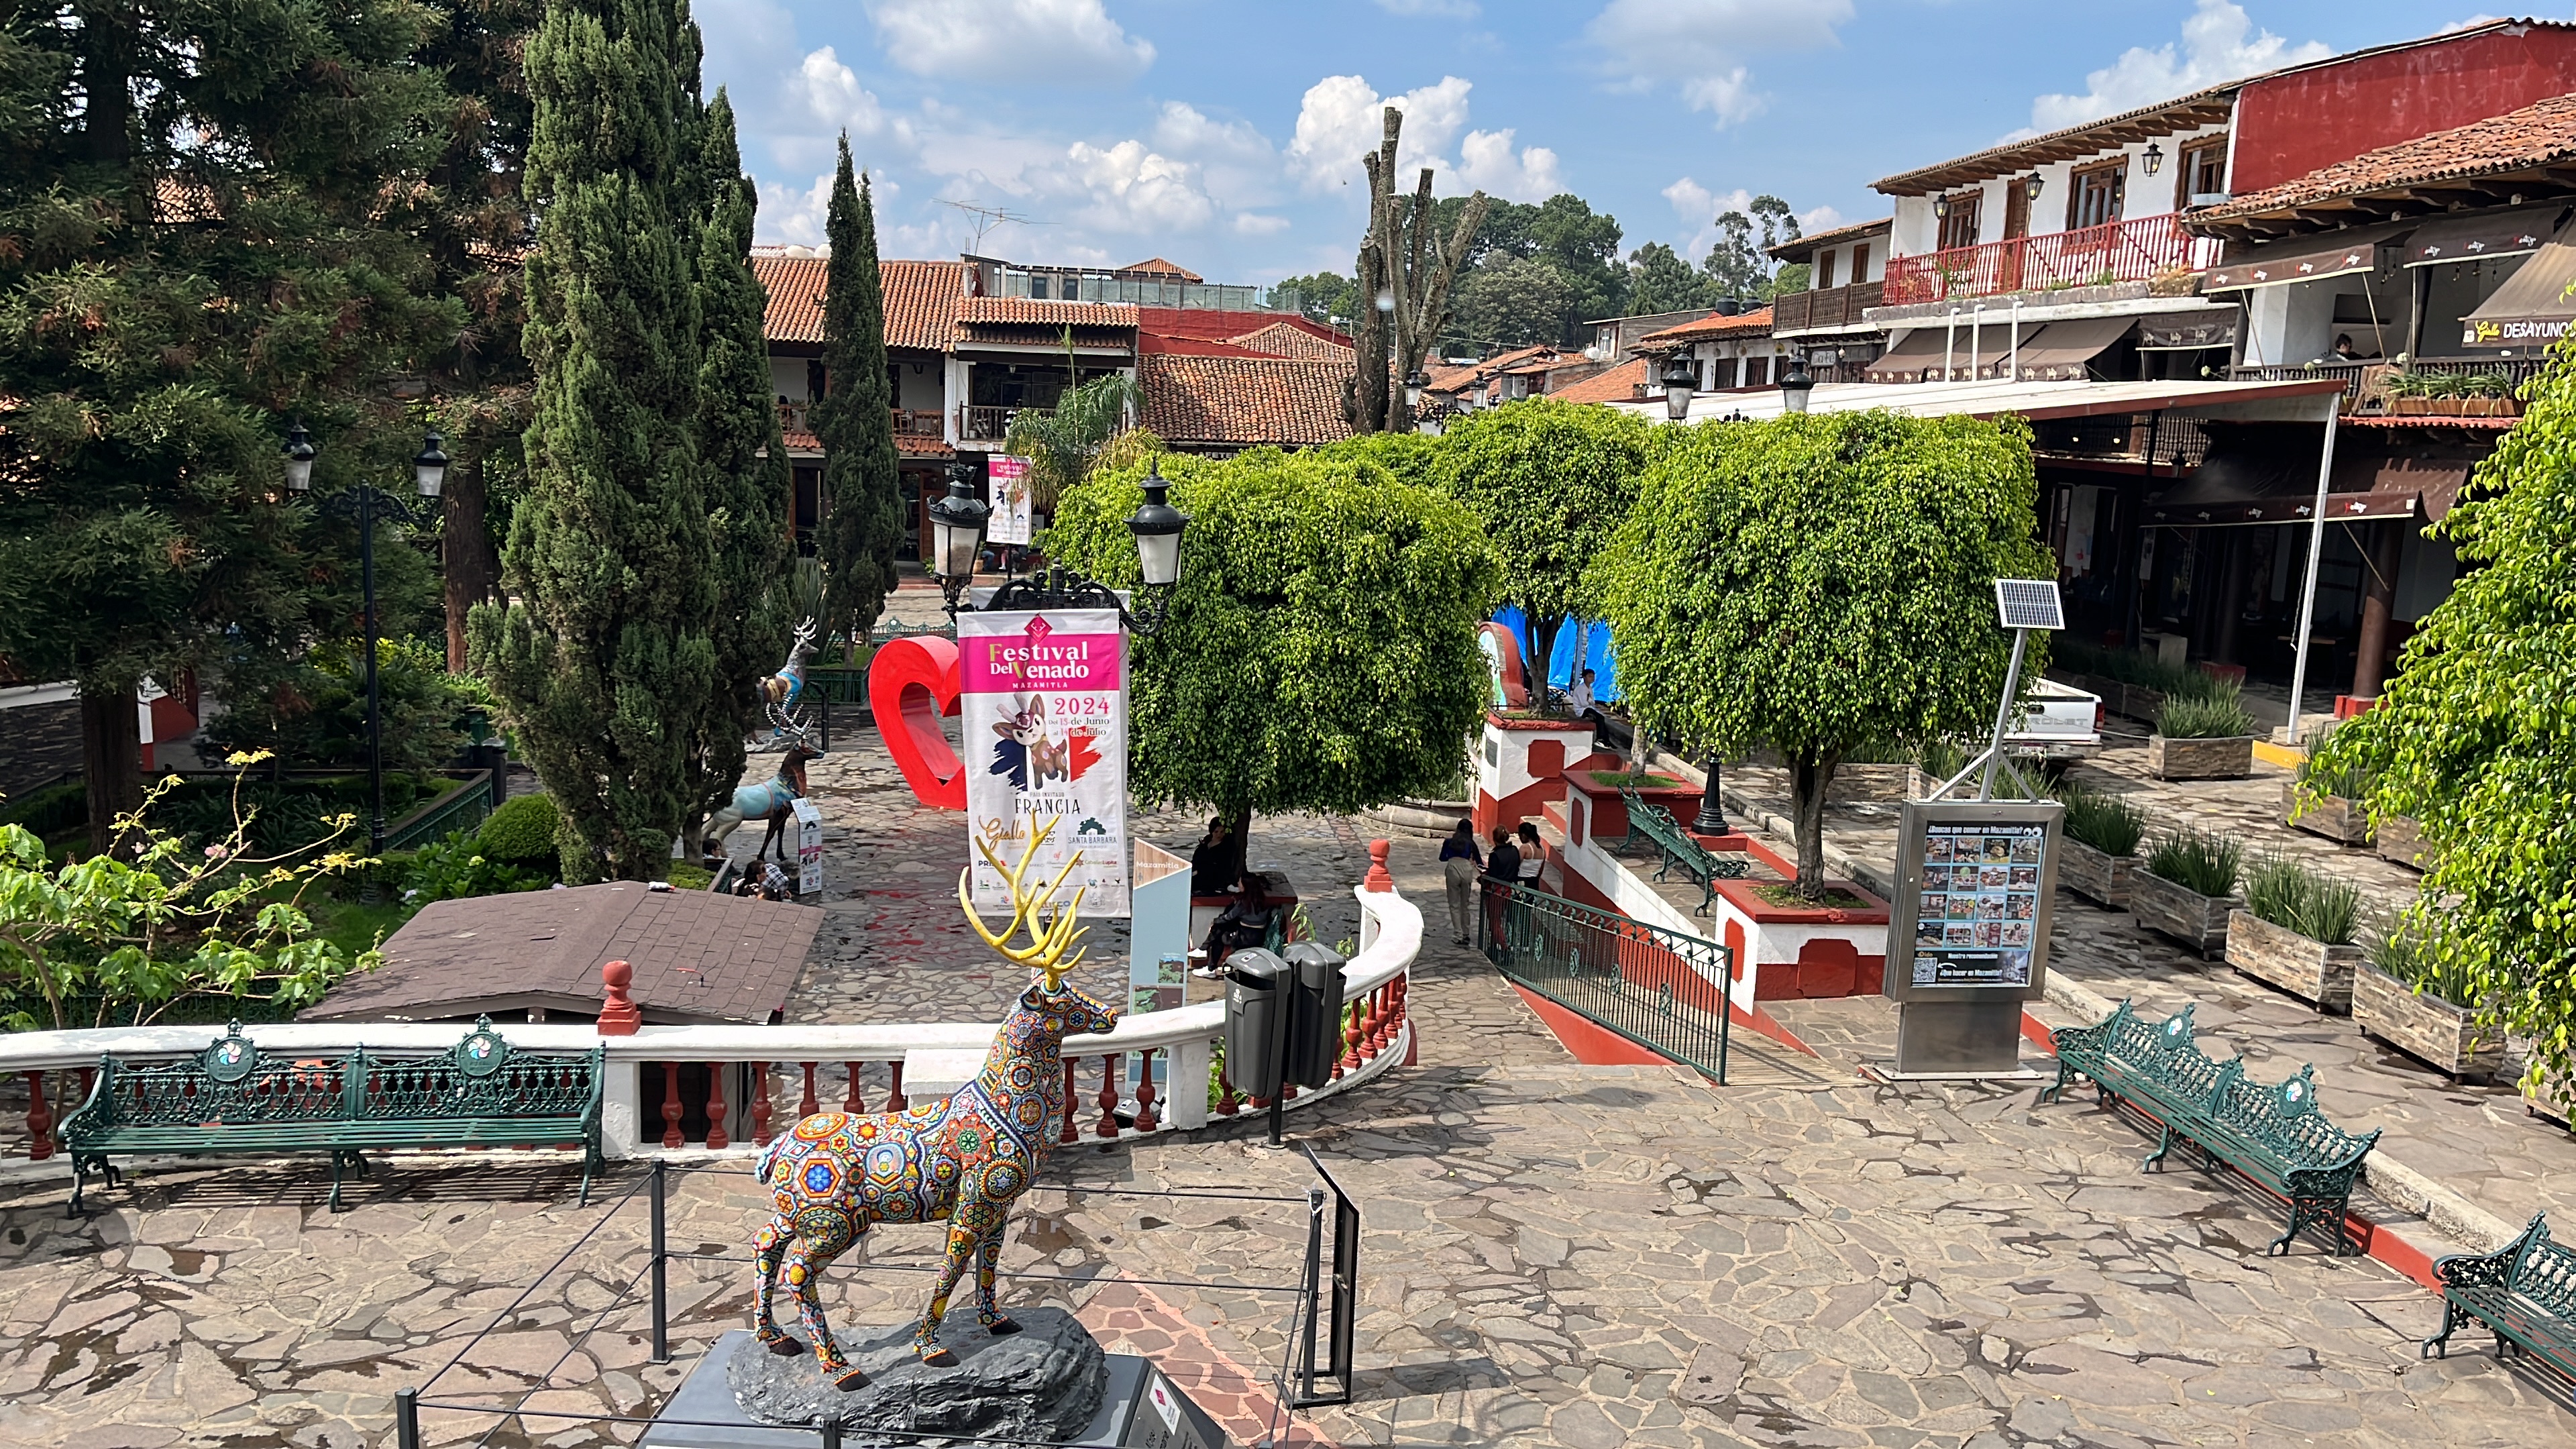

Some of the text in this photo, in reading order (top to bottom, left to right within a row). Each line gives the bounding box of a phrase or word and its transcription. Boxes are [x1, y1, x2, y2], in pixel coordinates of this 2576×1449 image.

[989, 641, 1088, 661] Festival
[990, 659, 1089, 679] Del Venado
[1055, 697, 1109, 715] 2024
[1071, 717, 1082, 725] de
[1084, 717, 1110, 725] Junio
[1071, 728, 1083, 736] de
[1085, 728, 1106, 736] Julio
[1015, 798, 1081, 815] FRANCIA
[978, 815, 1026, 853] Giallo
[1136, 861, 1179, 869] Mazamitla
